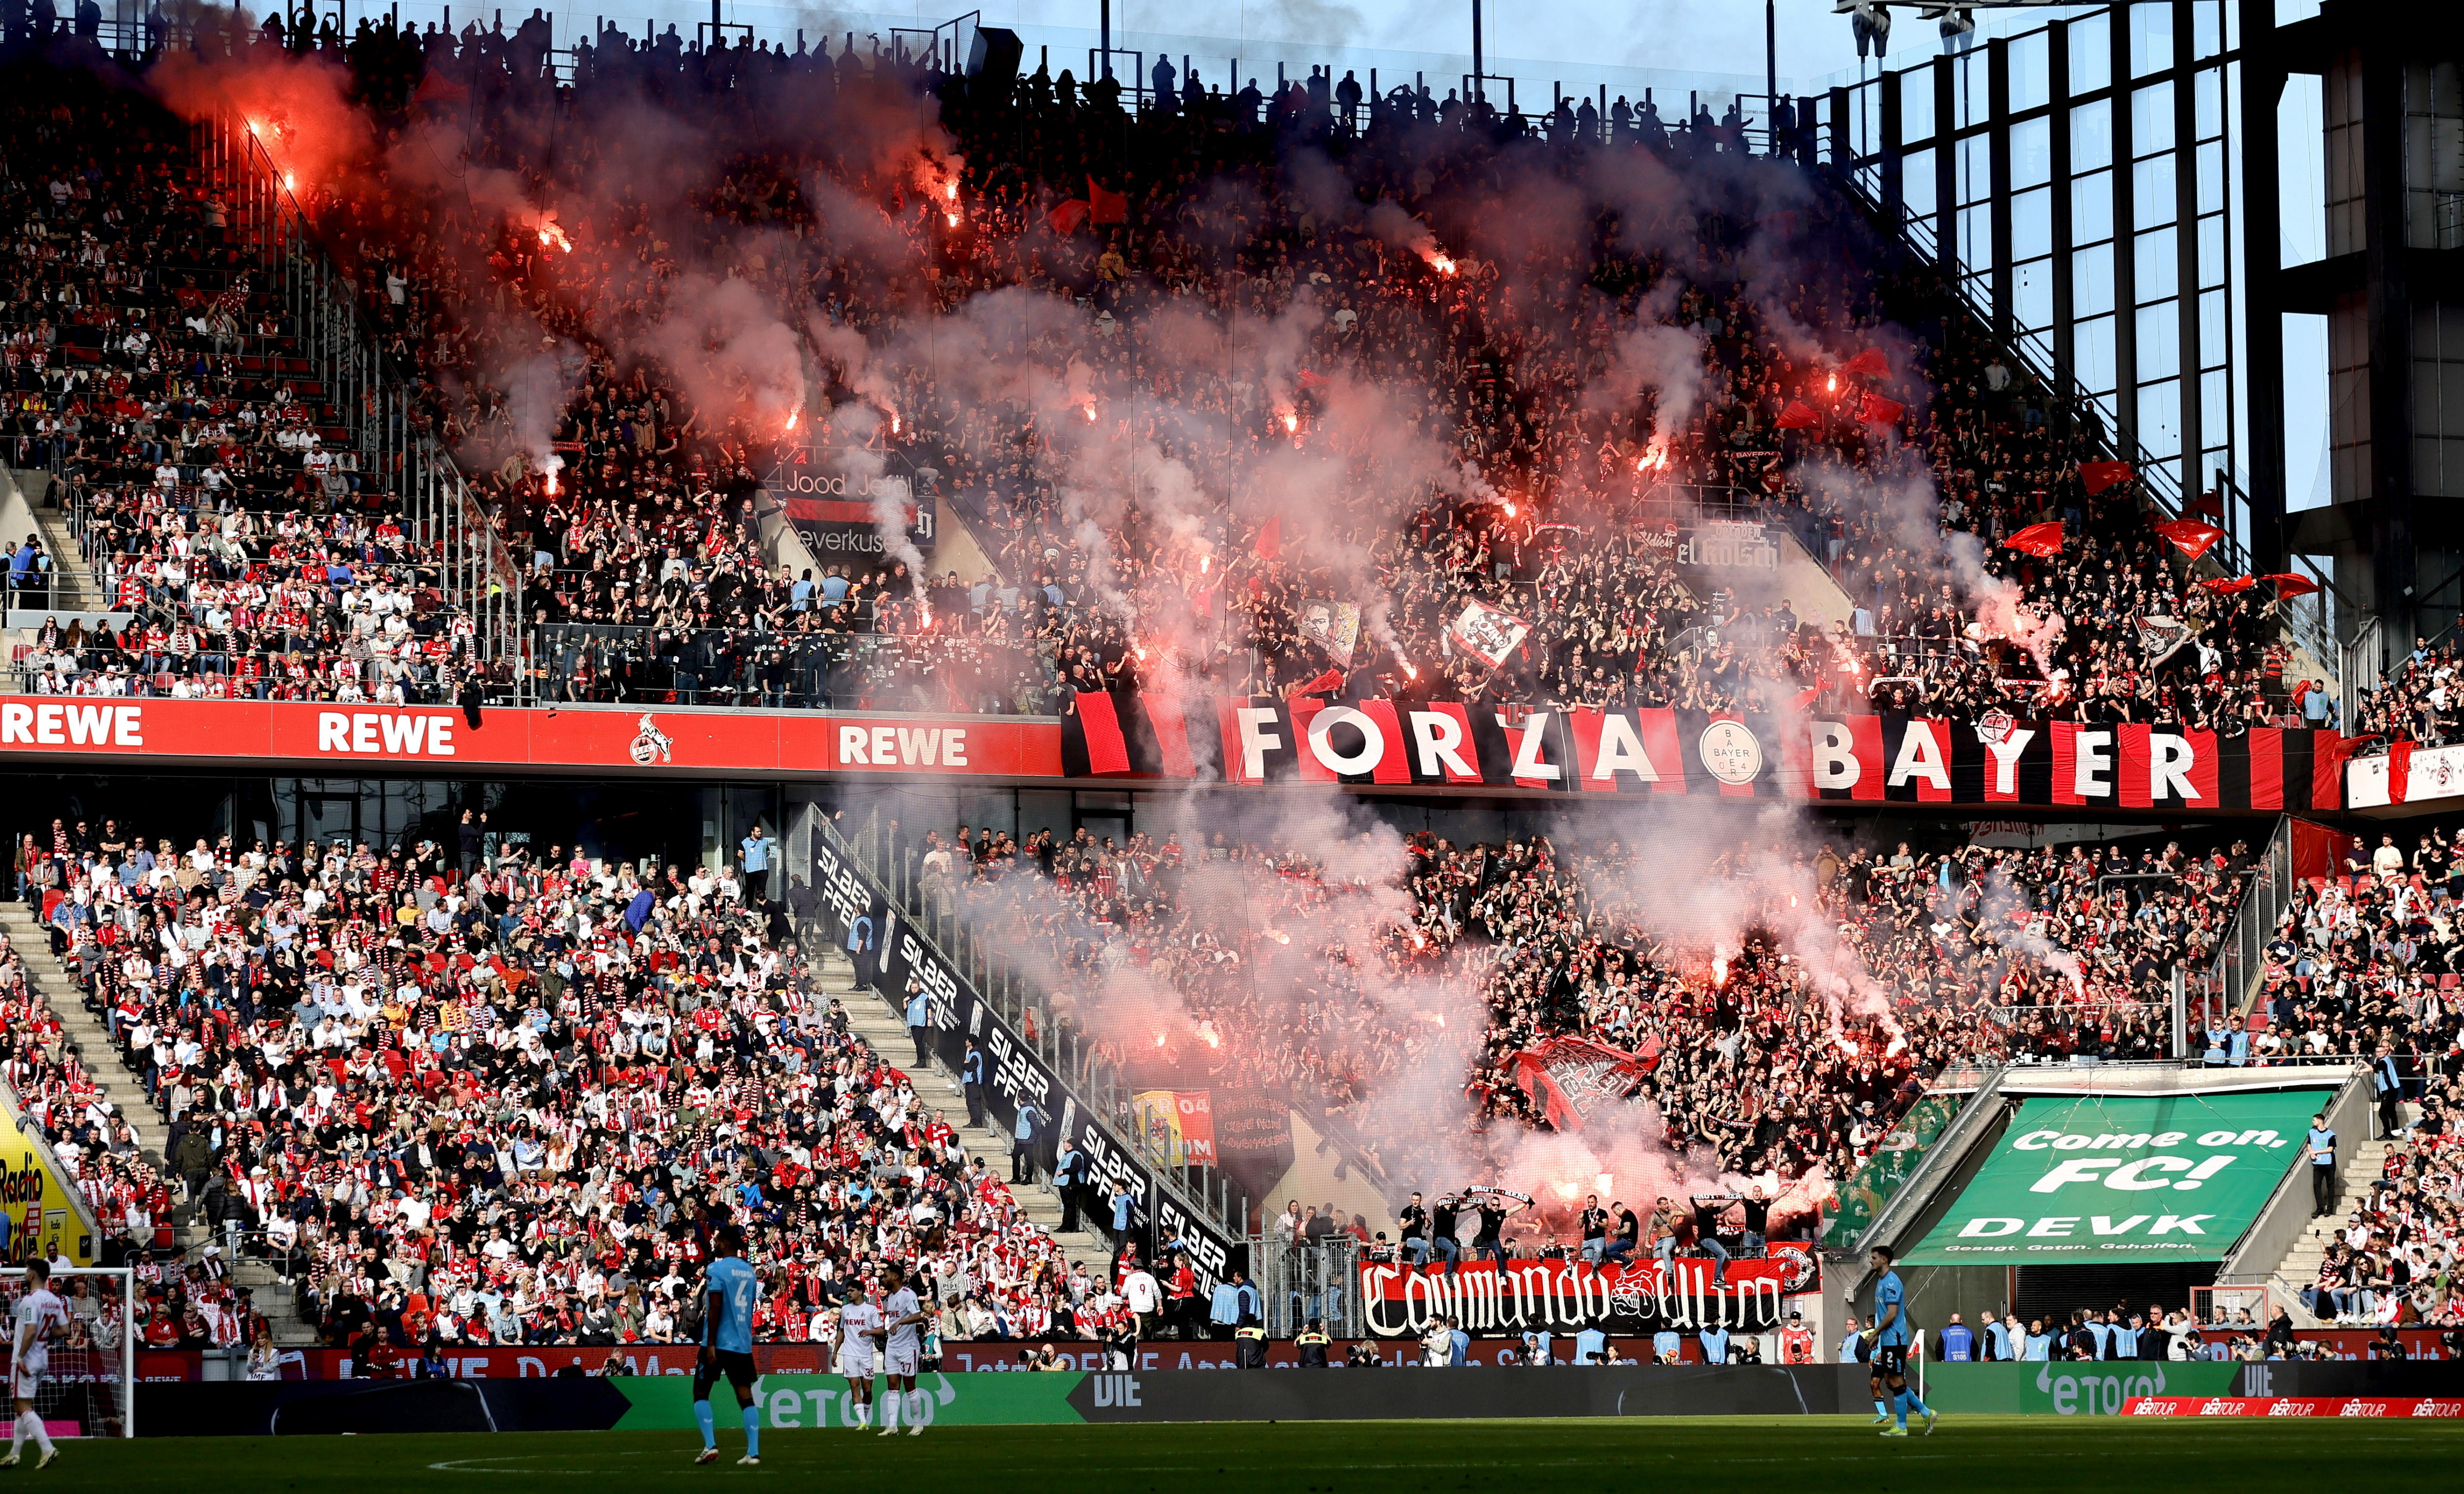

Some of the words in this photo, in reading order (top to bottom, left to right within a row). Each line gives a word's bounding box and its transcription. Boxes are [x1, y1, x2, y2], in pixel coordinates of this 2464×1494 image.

[787, 470, 846, 495] Jood
[1, 704, 143, 746] REWE
[319, 712, 455, 756] REWE
[839, 726, 968, 767] REWE
[1236, 706, 1660, 781] FORZA
[1713, 748, 1750, 758] BAYER
[1809, 720, 2202, 799] BAYER
[818, 845, 872, 912] SILBER
[822, 880, 857, 931] PFE
[900, 934, 957, 1009] SILBER
[944, 1014, 955, 1031] DRINK
[945, 1008, 960, 1027] ENERGY
[988, 1027, 1049, 1106] SILBER
[993, 1064, 1036, 1111] PFE
[1179, 1099, 1210, 1114] 04
[2012, 1129, 2189, 1151] Come
[2196, 1129, 2288, 1149] on,
[1082, 1124, 1146, 1205] SILBER
[2028, 1155, 2238, 1193] FC!
[1087, 1162, 1117, 1214] PFE
[1133, 1206, 1150, 1225] NERGY
[1956, 1214, 2217, 1238] DEVK
[1160, 1202, 1226, 1278] SILBER
[1944, 1245, 2019, 1253] Gesagt.
[2027, 1244, 2091, 1252] Getan.
[2100, 1242, 2196, 1250] Geholfen.
[735, 1281, 748, 1307] 4
[1139, 1284, 1145, 1295] 9
[900, 1362, 912, 1373] 37
[1887, 1352, 1893, 1363] 2
[865, 1368, 874, 1377] 35
[2133, 1401, 2177, 1415] DERTOUR
[2200, 1401, 2245, 1415] DERTOUR
[2268, 1402, 2315, 1416] DERTOUR
[2339, 1402, 2387, 1417] DERTOUR
[2411, 1402, 2462, 1417] DERTOUR
